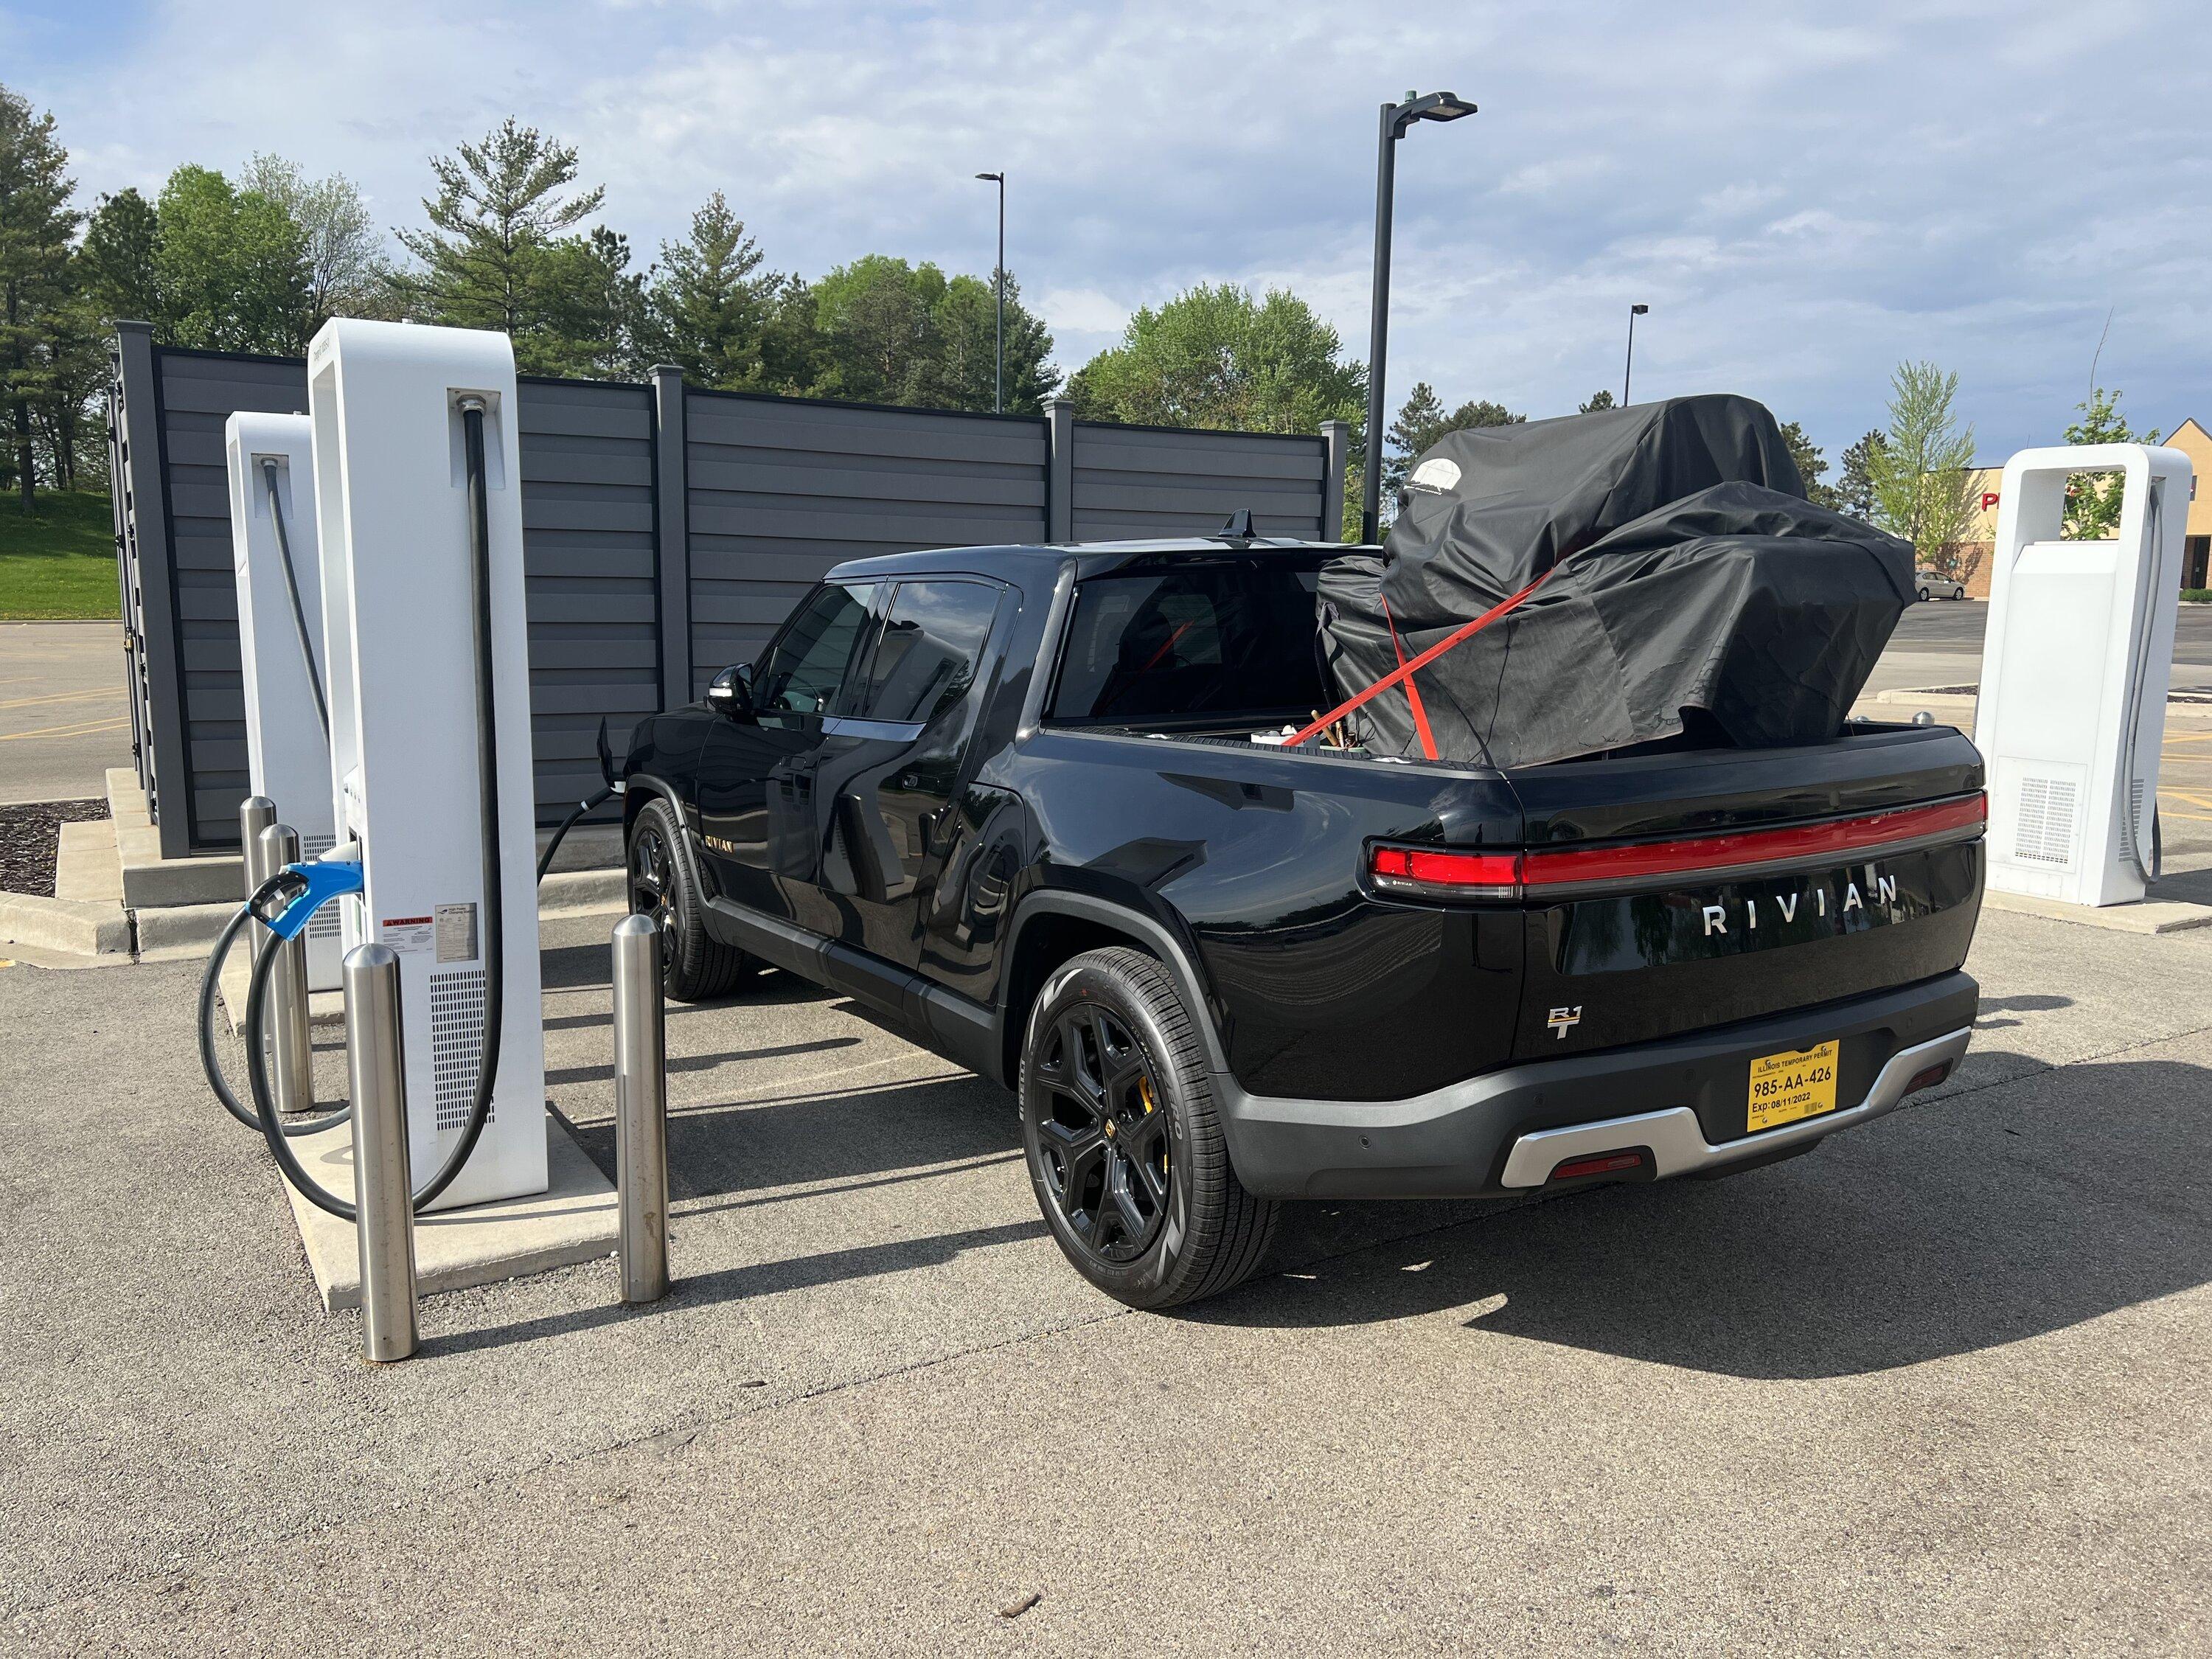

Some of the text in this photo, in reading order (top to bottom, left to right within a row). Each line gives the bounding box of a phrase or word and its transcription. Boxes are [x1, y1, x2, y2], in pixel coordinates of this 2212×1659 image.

[705, 835, 732, 853] RIVIAN
[1702, 874, 1897, 936] RIVIAN
[391, 917, 430, 926] WARNING
[1758, 1049, 1833, 1074] ILLINOIS TEMPORARY PERMIT
[1754, 1066, 1831, 1099] 985-AA-426
[1771, 1091, 1811, 1109] 08/11/2022
